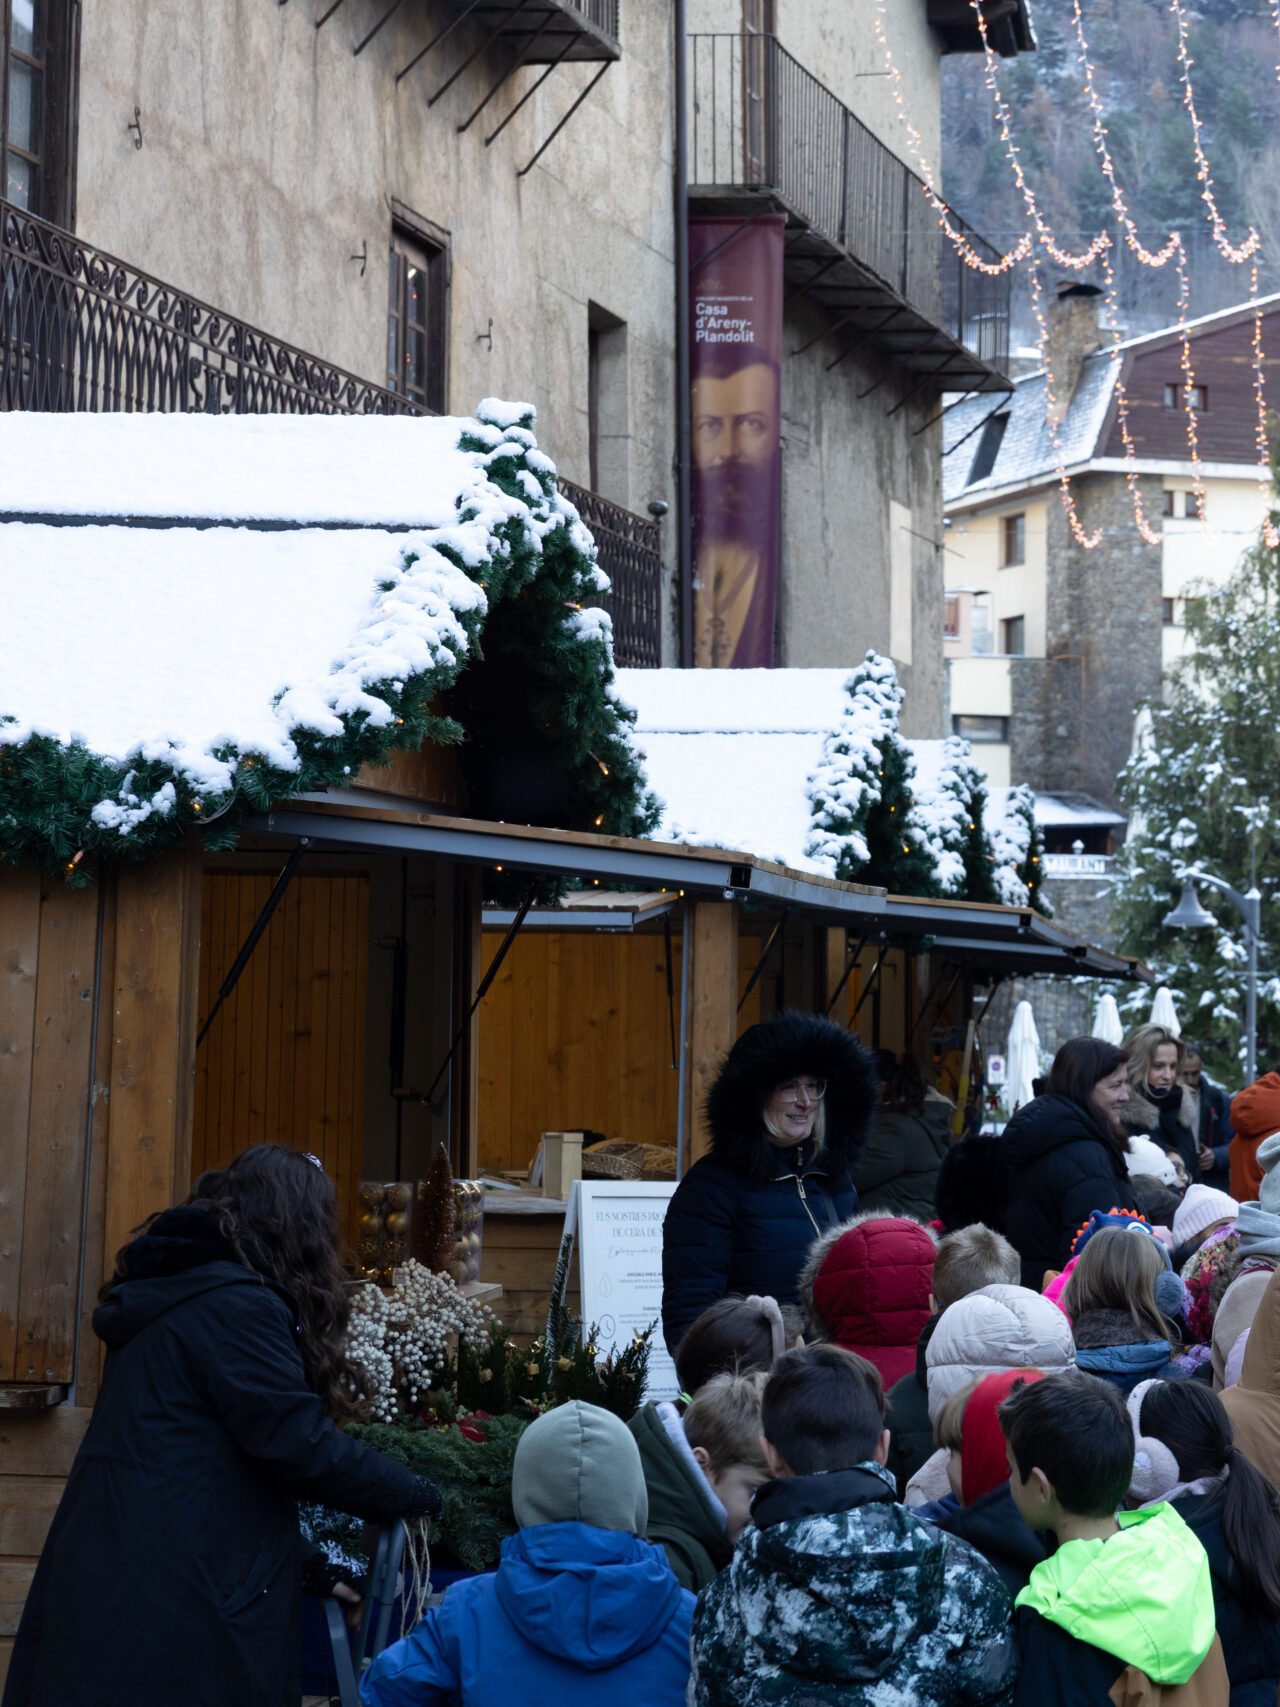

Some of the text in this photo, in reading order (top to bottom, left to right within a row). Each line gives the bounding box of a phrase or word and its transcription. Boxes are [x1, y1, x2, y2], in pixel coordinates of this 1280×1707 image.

[696, 302, 728, 315] Casa
[696, 330, 754, 343] Plandolit
[596, 1211, 611, 1221] ELS
[611, 1211, 647, 1221] NOSTRES
